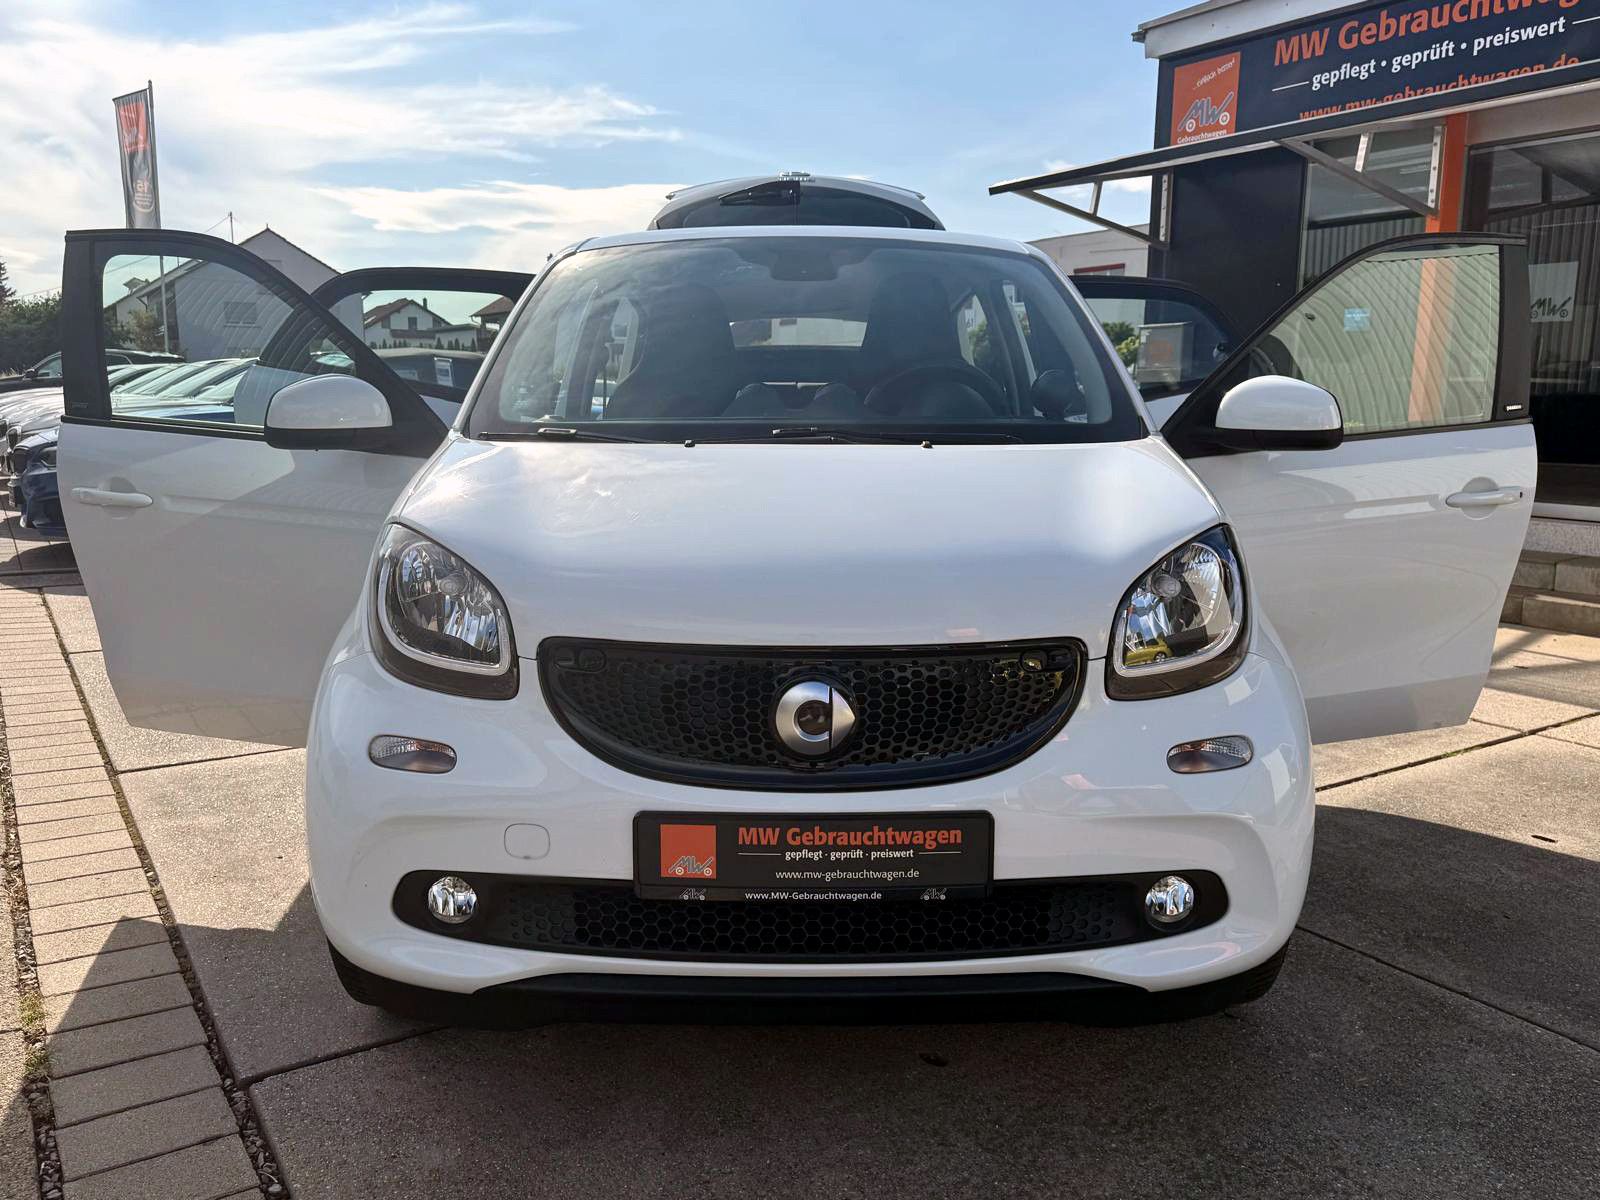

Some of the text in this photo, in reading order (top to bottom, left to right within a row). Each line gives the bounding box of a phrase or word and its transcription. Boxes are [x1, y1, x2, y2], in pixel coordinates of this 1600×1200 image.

[1274, 0, 1579, 67] MW Gebraucht
[1311, 15, 1566, 91] gepflegt geprüft preiswert
[738, 825, 962, 849] MW Gebrauchtwagen
[785, 849, 914, 861] gepflegt geprüft preiswert
[776, 868, 920, 882] www.mw-gebrauchtwagen.de
[744, 891, 882, 902] www.MW-Gebrauchtwagen.de
